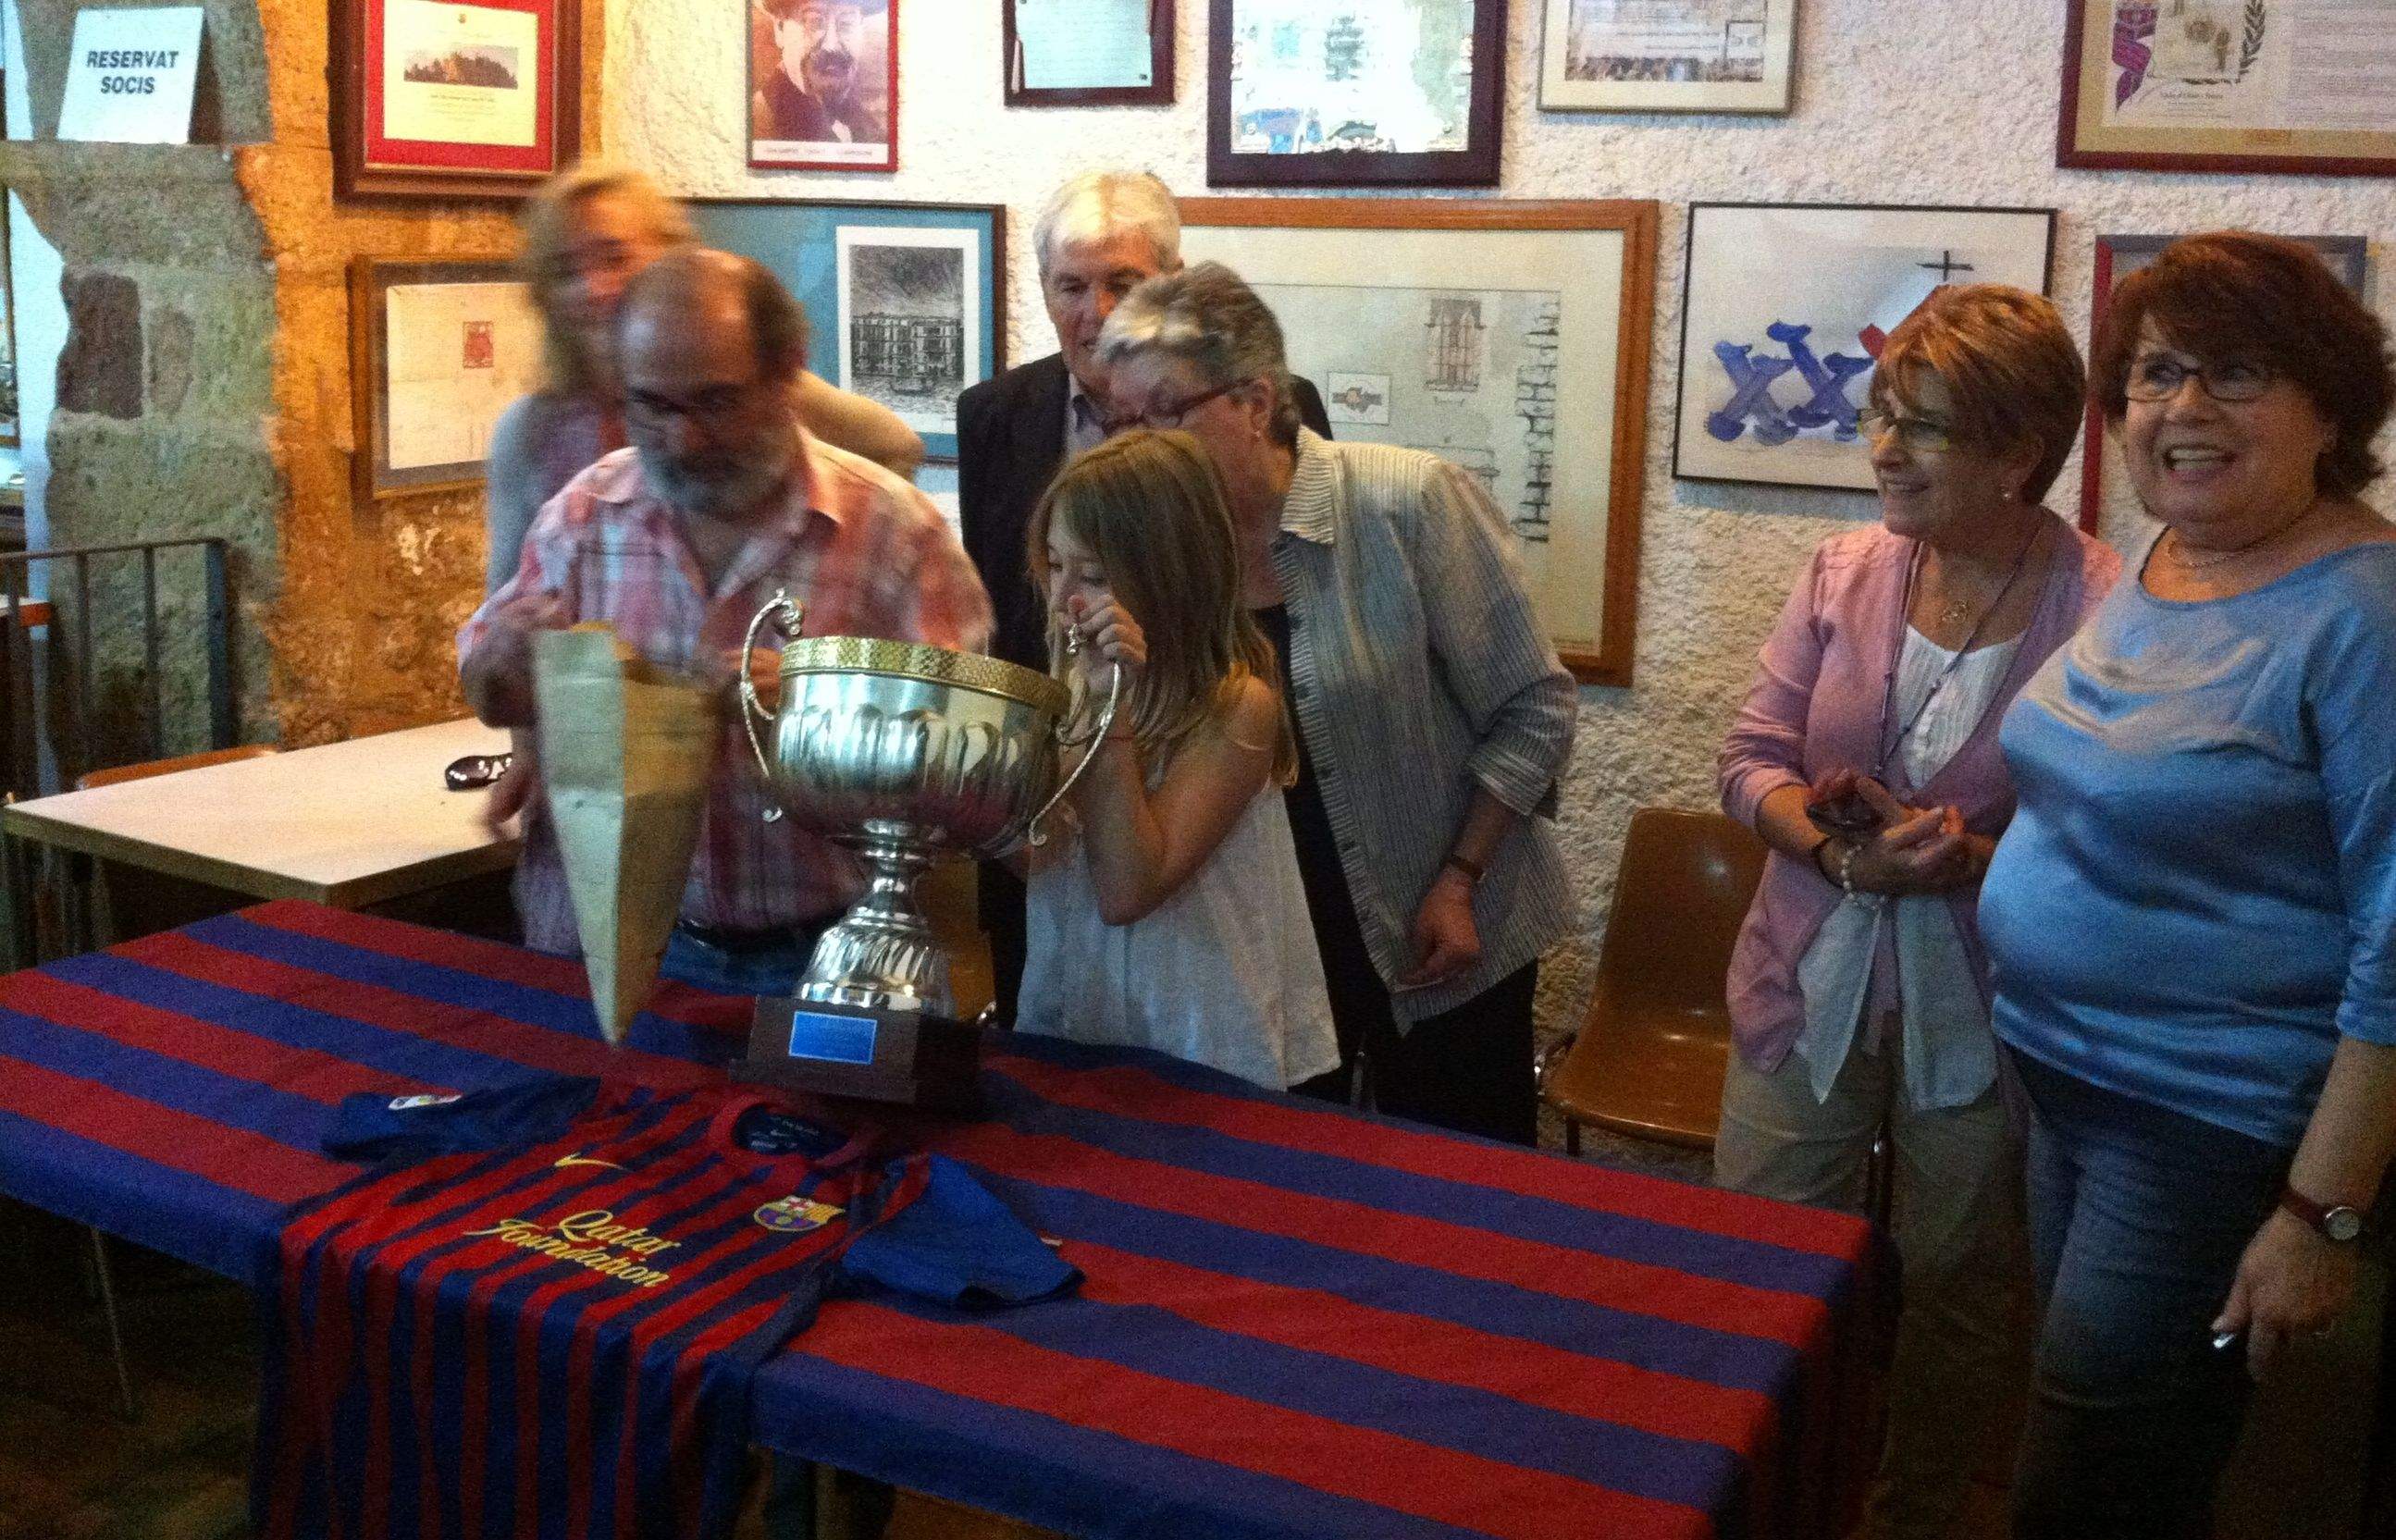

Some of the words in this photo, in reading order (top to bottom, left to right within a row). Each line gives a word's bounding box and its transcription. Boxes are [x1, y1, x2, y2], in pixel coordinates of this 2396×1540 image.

[87, 50, 179, 68] RESERVAT
[100, 76, 155, 94] SOCIS
[550, 1209, 683, 1255] Qatar
[463, 1218, 670, 1287] Foundation
